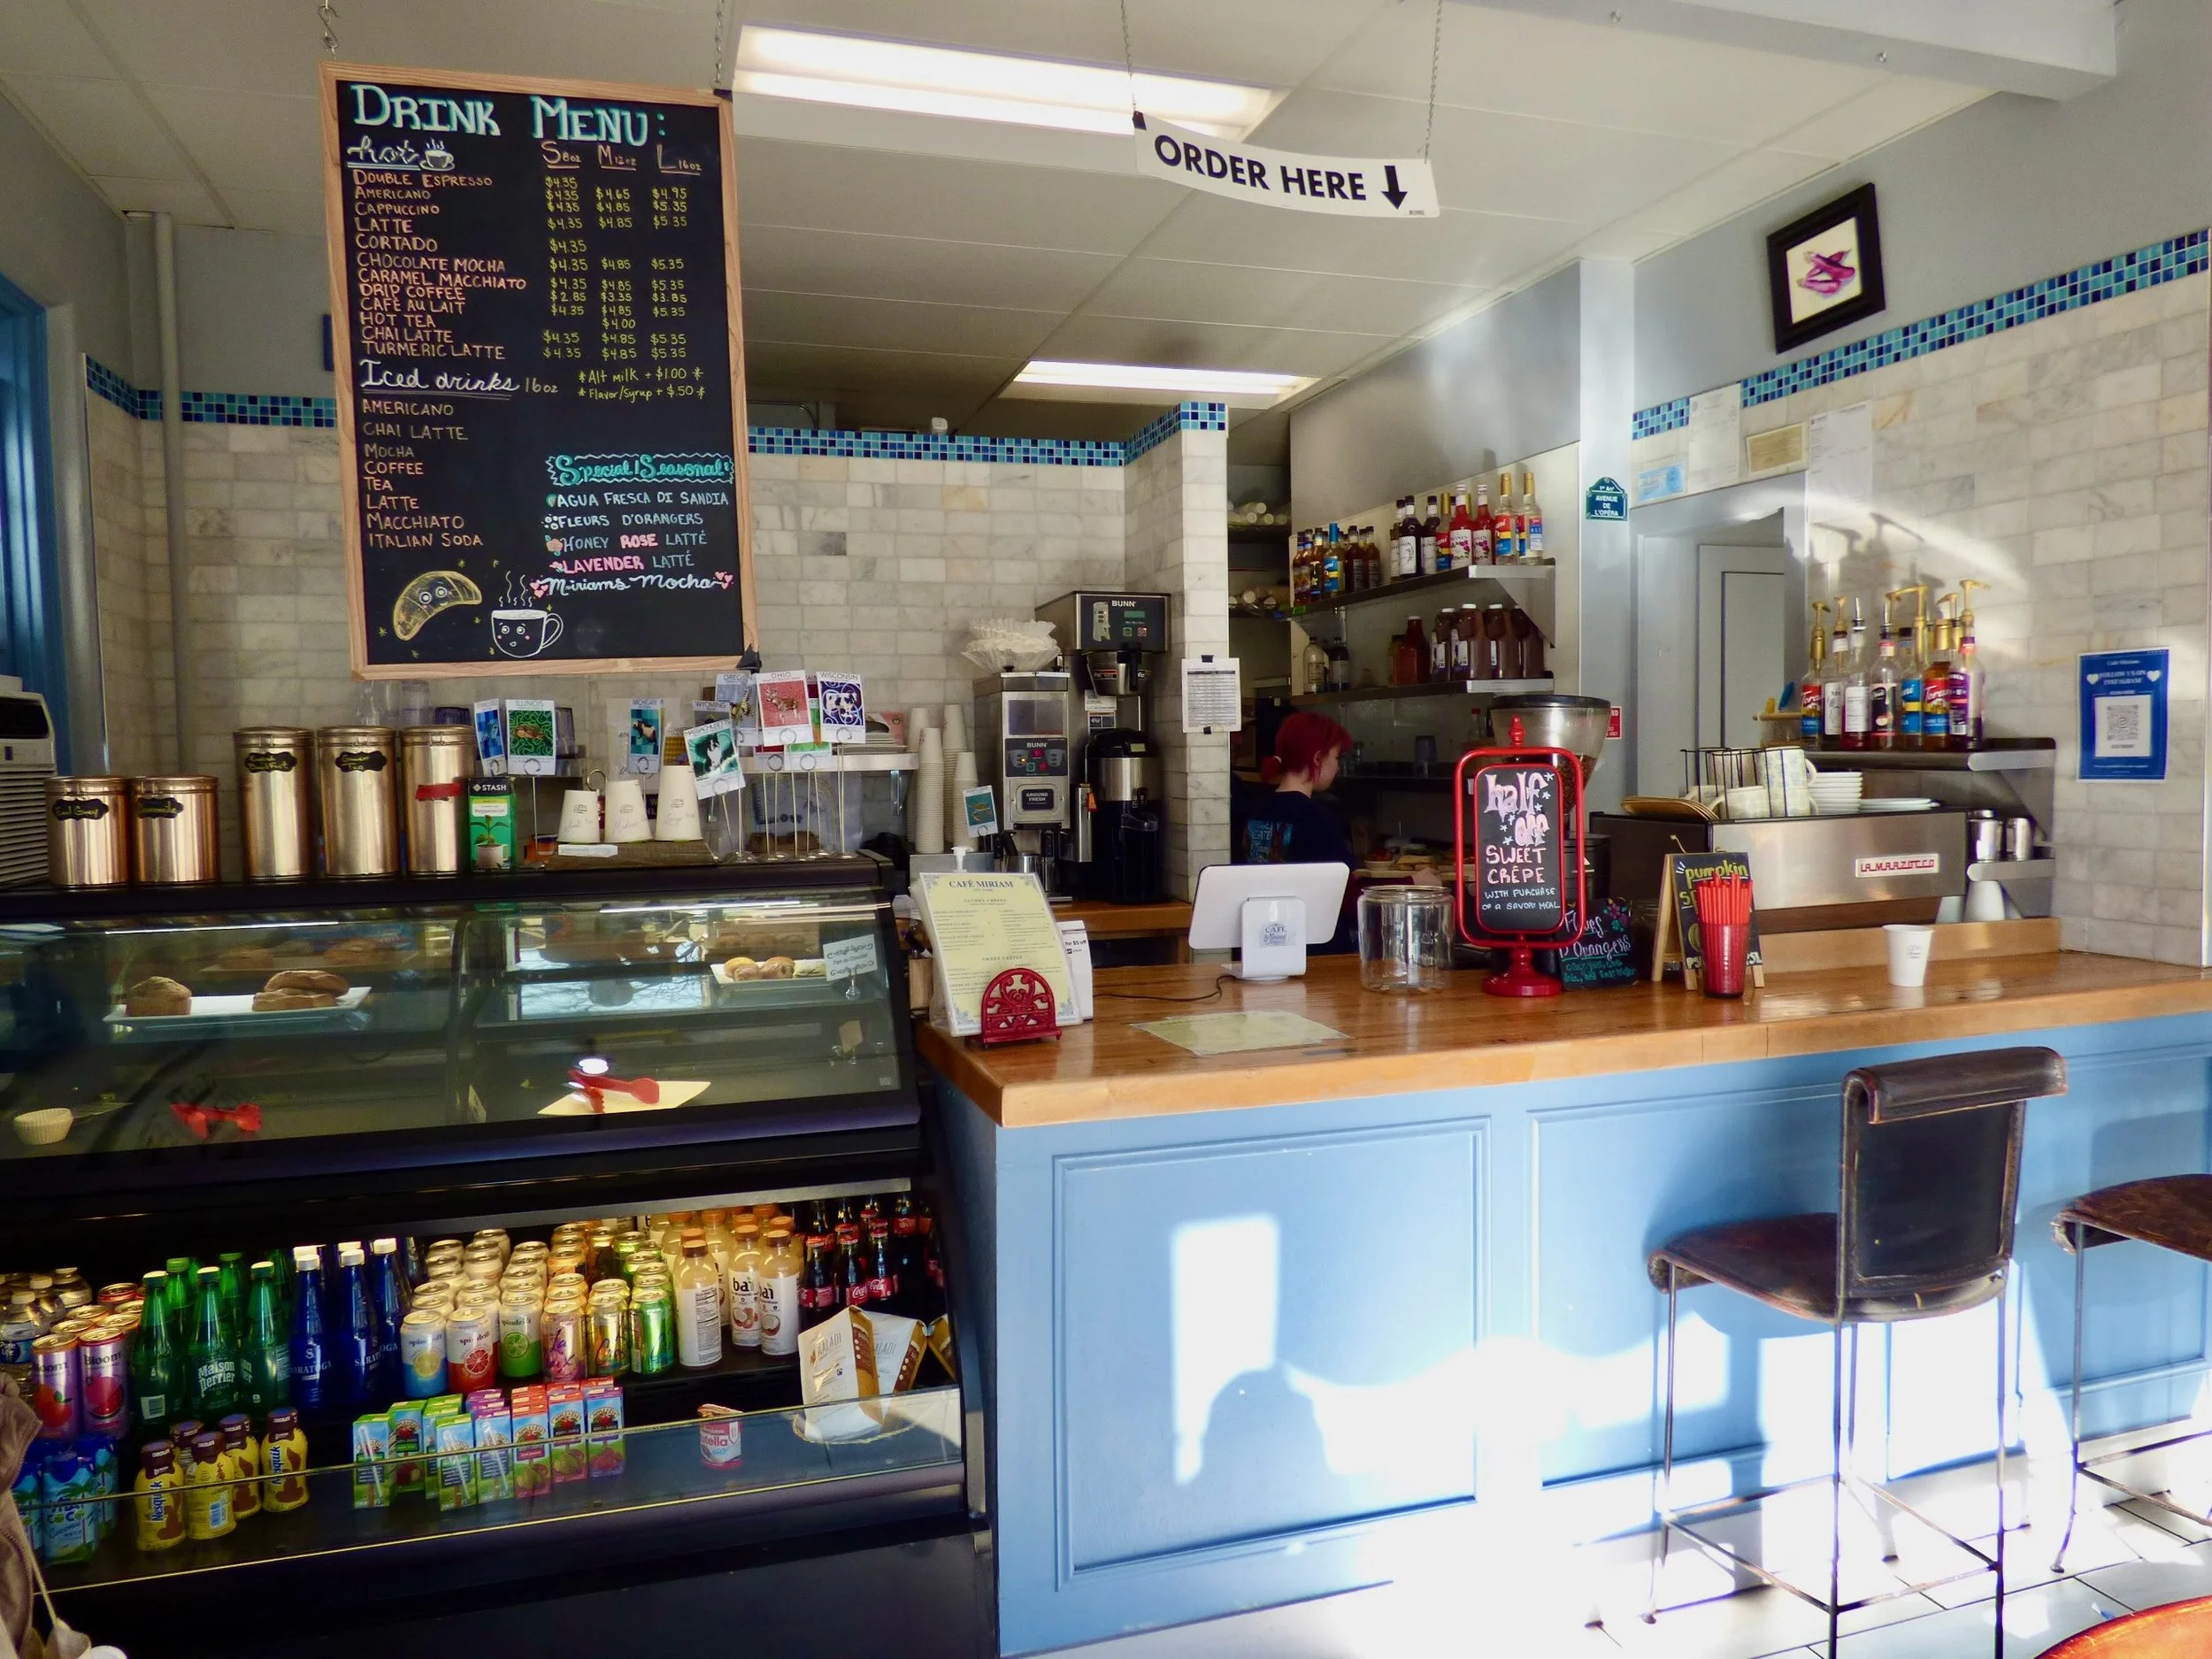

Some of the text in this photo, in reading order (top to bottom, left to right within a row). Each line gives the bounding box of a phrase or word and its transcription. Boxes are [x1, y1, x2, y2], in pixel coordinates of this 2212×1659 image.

[349, 84, 501, 136] DRINK
[347, 134, 420, 165] hot
[1154, 134, 1367, 201] ORDER HERE
[353, 169, 579, 189] DOUBLE ESPRESSO $4.35
[354, 186, 687, 203] AMERICANO $4.35 $4.65 $4.95
[354, 202, 441, 217] CAPPUCCINO
[546, 201, 580, 213] $4.35
[651, 200, 687, 212] $5.35
[354, 218, 413, 234] LATTE
[547, 217, 583, 231] $4.35
[652, 215, 687, 230] $5.35
[356, 234, 588, 254] CORTADO $4.35
[357, 251, 449, 272] CHOCOLATE
[453, 258, 506, 273] MOCHA
[549, 257, 588, 273] $4.35
[650, 257, 685, 271] $5.35
[357, 268, 434, 287] CARAMEL
[438, 273, 527, 290] MACCHIATO
[549, 277, 588, 290] $4.35
[651, 279, 685, 292] $5.35
[359, 283, 401, 298] DRIP
[405, 286, 466, 302] COFFEE
[600, 290, 633, 303] $3.35
[407, 298, 426, 312] AU
[430, 300, 466, 315] LAIT
[550, 303, 586, 318] $4.35
[652, 305, 686, 318] $5.35
[359, 311, 636, 331] HOT TEA $4.00
[361, 326, 399, 342] CHAI
[403, 328, 454, 344] LATTE
[542, 329, 580, 344] $4.35
[650, 332, 687, 346] $5.35
[362, 340, 448, 357] TURMERIC
[450, 343, 507, 361] LATTE
[542, 347, 582, 360] $4.35
[650, 347, 687, 361] $5.35
[359, 358, 430, 388] Iced
[434, 370, 521, 392] drinks
[612, 367, 640, 383] milk
[588, 386, 653, 403] Flavor/Syrup
[362, 398, 454, 416] AMERICANO
[363, 421, 469, 441] CHAI LATTE
[364, 442, 414, 458] MOCHA
[364, 460, 424, 475] COFFEE
[364, 476, 394, 492] TEA
[365, 494, 420, 512] LATTE
[557, 493, 599, 508] AGUA
[603, 492, 651, 506] FRESCA
[680, 492, 729, 506] SANDIA
[365, 512, 465, 531] MACCHIATO
[558, 512, 703, 528] FLEURS D'ORANGERS
[368, 532, 483, 549] ITALIAN SODA
[562, 535, 610, 553] HONEY
[619, 533, 659, 550] ROSE
[562, 555, 645, 575] LAVENDER
[629, 573, 723, 590] Mocha
[771, 671, 792, 680] OHIO
[819, 672, 859, 681] WISCONSIN
[632, 697, 658, 706] MICHIGAN
[694, 700, 726, 709] WYOMING
[481, 783, 507, 792] STASH
[1483, 771, 1548, 822] half
[1514, 812, 1550, 847] off
[1486, 845, 1548, 865] SWEET
[949, 879, 973, 889] CAFÉ
[1486, 865, 1546, 885] CRÊPE
[1484, 887, 1556, 900] WITH PURCHASE
[1539, 902, 1561, 910] MEAL
[197, 1360, 235, 1379] Maison
[269, 1445, 281, 1486] Nsquik
